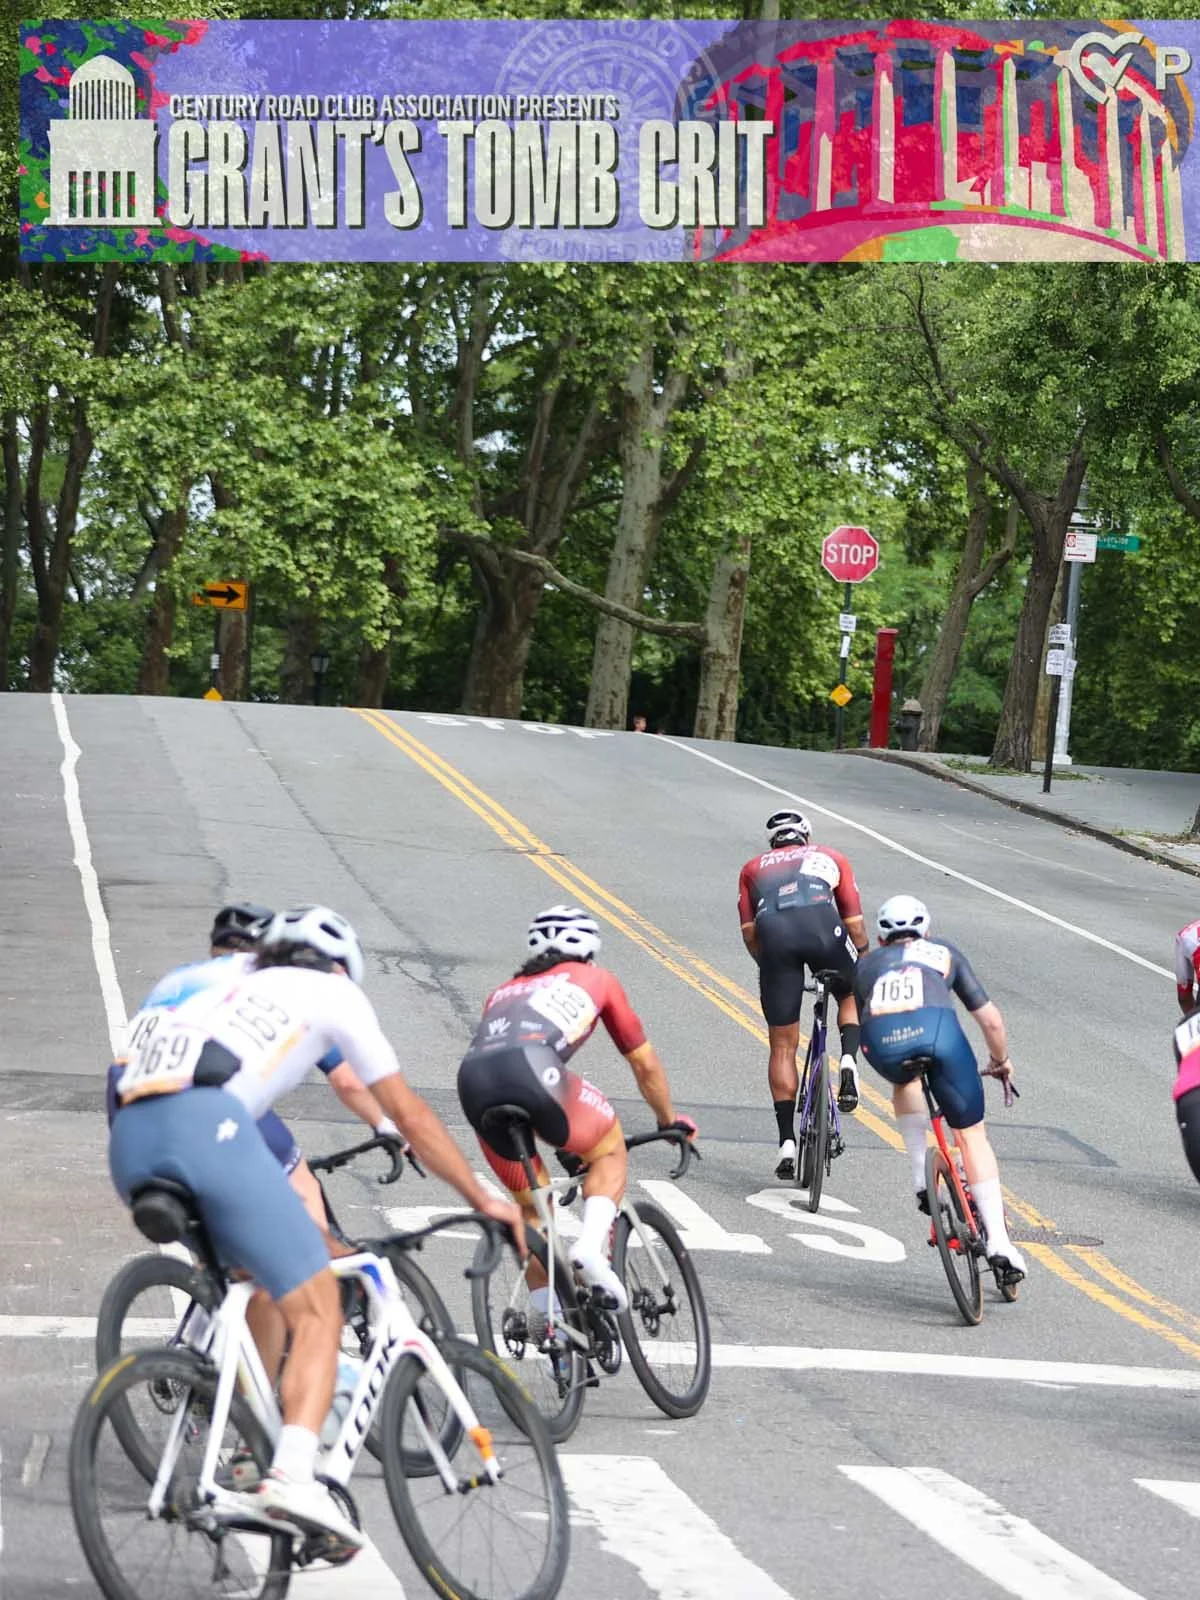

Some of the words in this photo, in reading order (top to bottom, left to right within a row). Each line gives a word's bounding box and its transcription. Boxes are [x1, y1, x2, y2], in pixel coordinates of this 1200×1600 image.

[826, 543, 874, 566] STOP
[416, 714, 616, 740] STOP
[881, 977, 914, 1002] 165
[228, 996, 290, 1051] 169
[344, 1337, 399, 1460] LOOK
